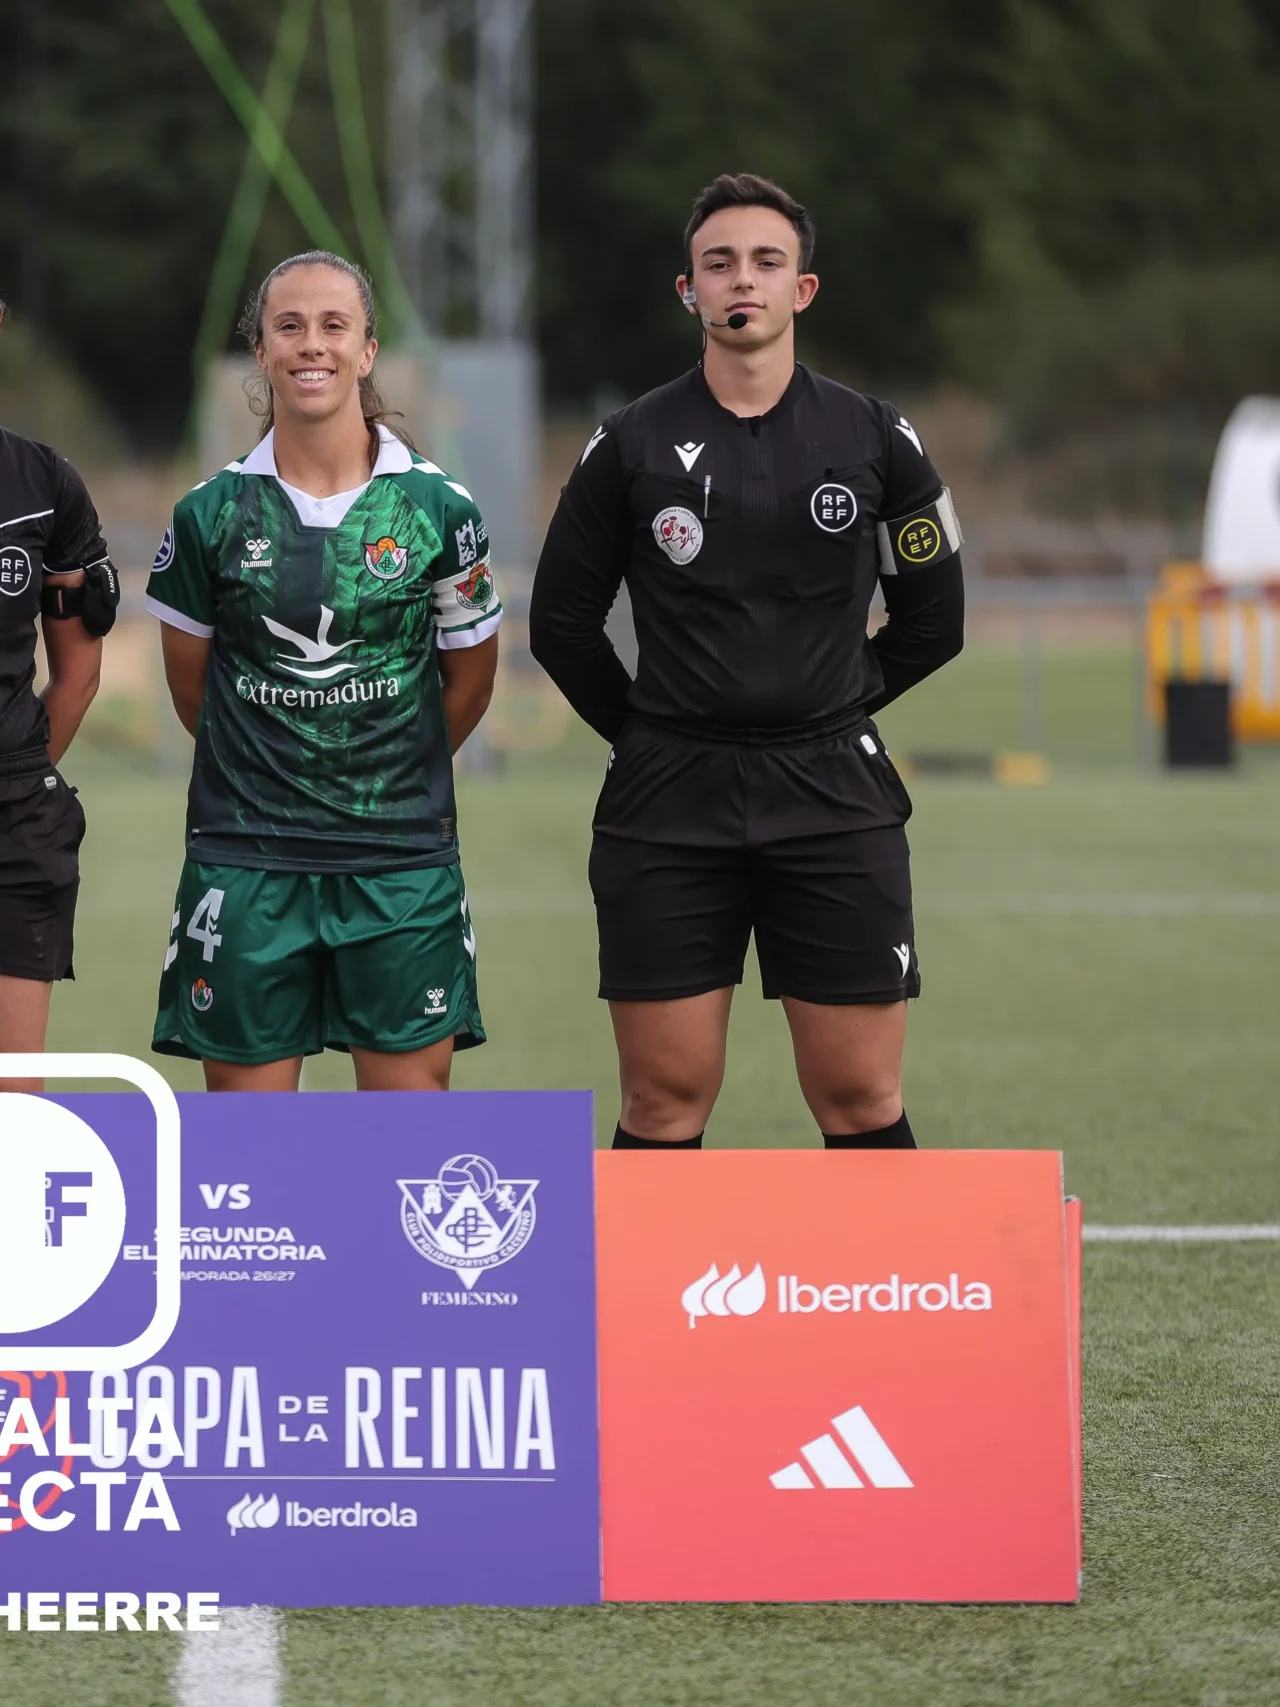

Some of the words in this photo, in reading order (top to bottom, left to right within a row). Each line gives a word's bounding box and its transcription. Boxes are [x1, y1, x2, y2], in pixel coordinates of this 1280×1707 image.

[822, 494, 847, 506] RF
[822, 508, 848, 520] EF
[907, 526, 929, 543] RF
[910, 537, 932, 554] EF
[1, 557, 25, 570] RF
[240, 558, 273, 569] hummel
[1, 571, 24, 585] EF
[236, 675, 400, 708] Extremadura
[186, 887, 226, 963] 4
[199, 1183, 252, 1210] VS
[153, 1226, 296, 1243] EGUNDA
[405, 1211, 421, 1239] CLUB
[416, 1236, 500, 1268] POLIDEPORTIVO
[122, 1244, 327, 1261] ELMINATORIA
[152, 1270, 251, 1281] MPORADA
[421, 1291, 518, 1306] FEMENINO
[776, 1272, 993, 1314] Iberdrola
[278, 1395, 329, 1415] DE
[344, 1366, 557, 1471] REINA
[278, 1423, 330, 1443] LA
[285, 1501, 418, 1529] Iberdrola
